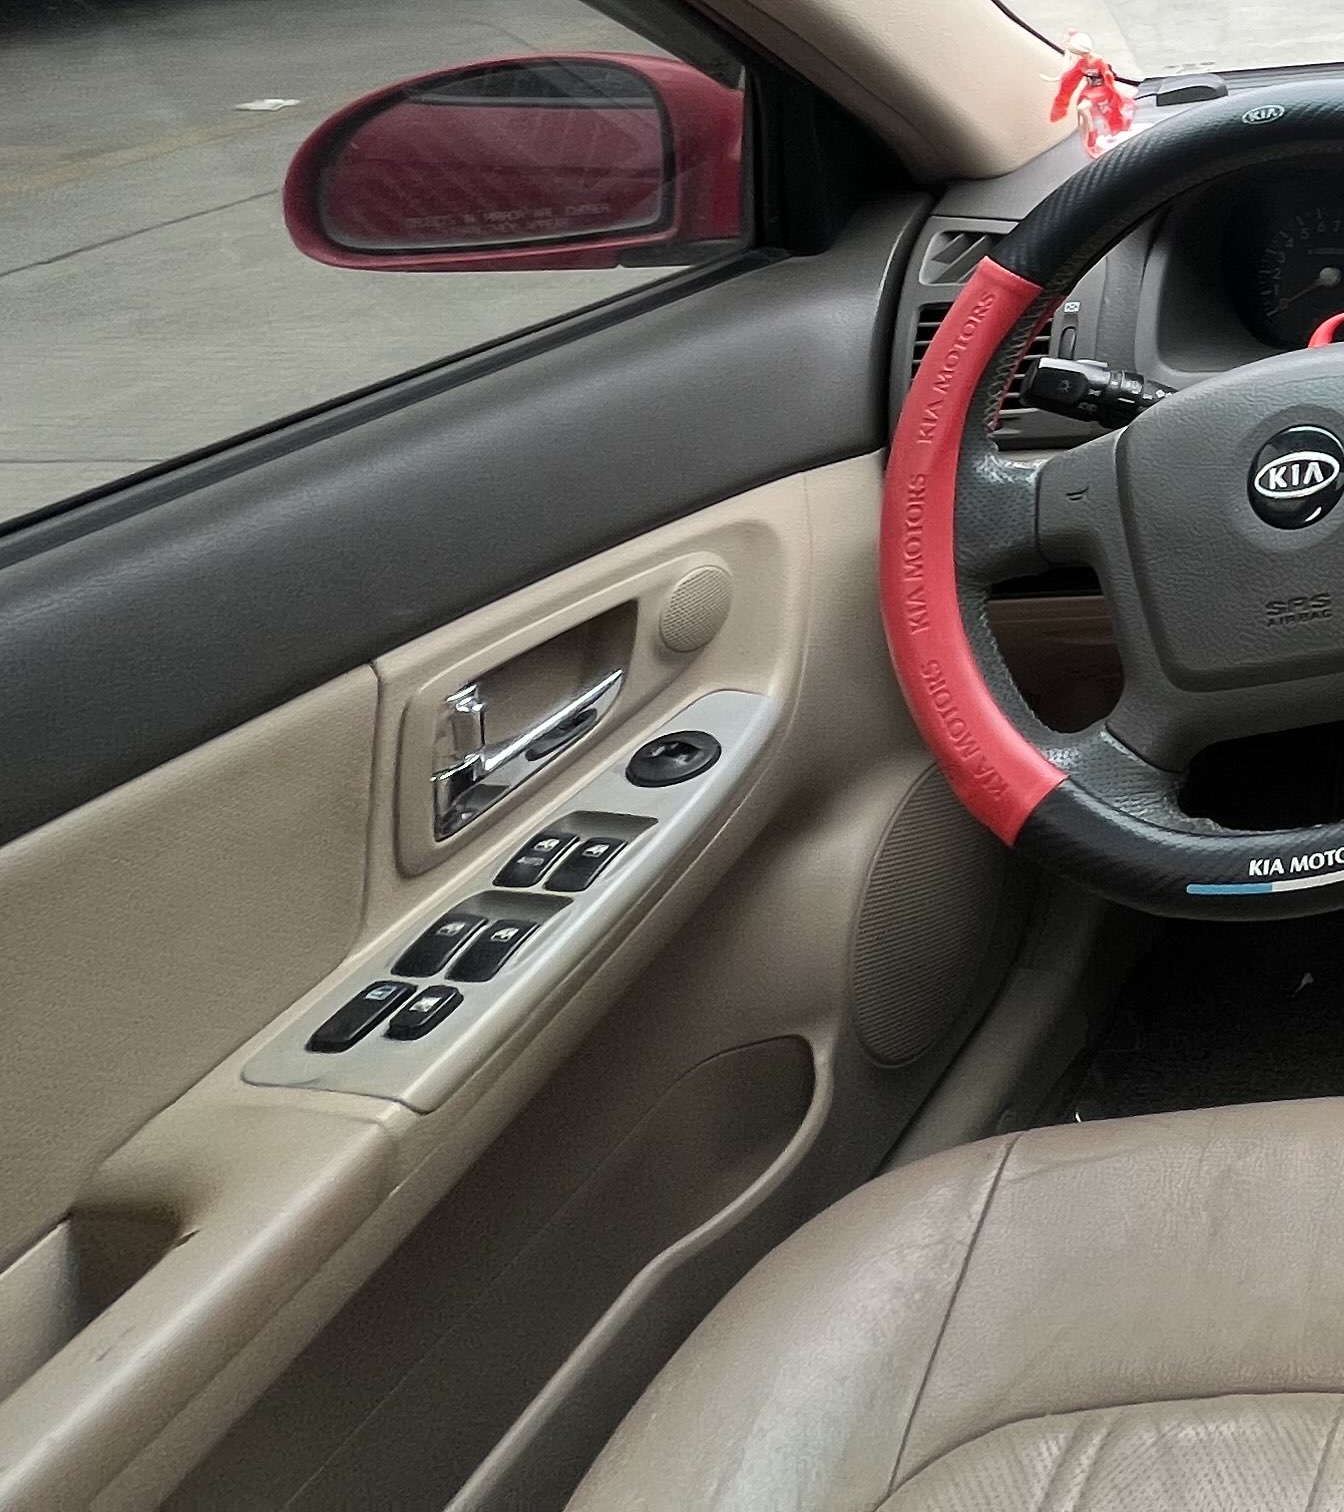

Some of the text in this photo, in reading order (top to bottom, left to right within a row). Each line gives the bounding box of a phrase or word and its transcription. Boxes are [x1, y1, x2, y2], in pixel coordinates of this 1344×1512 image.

[917, 291, 995, 445] KIA MOTORS
[1268, 461, 1324, 490] KIA
[903, 472, 930, 636] KIA MOTORS
[920, 659, 981, 763] MOTORS
[1249, 858, 1285, 876] KIA
